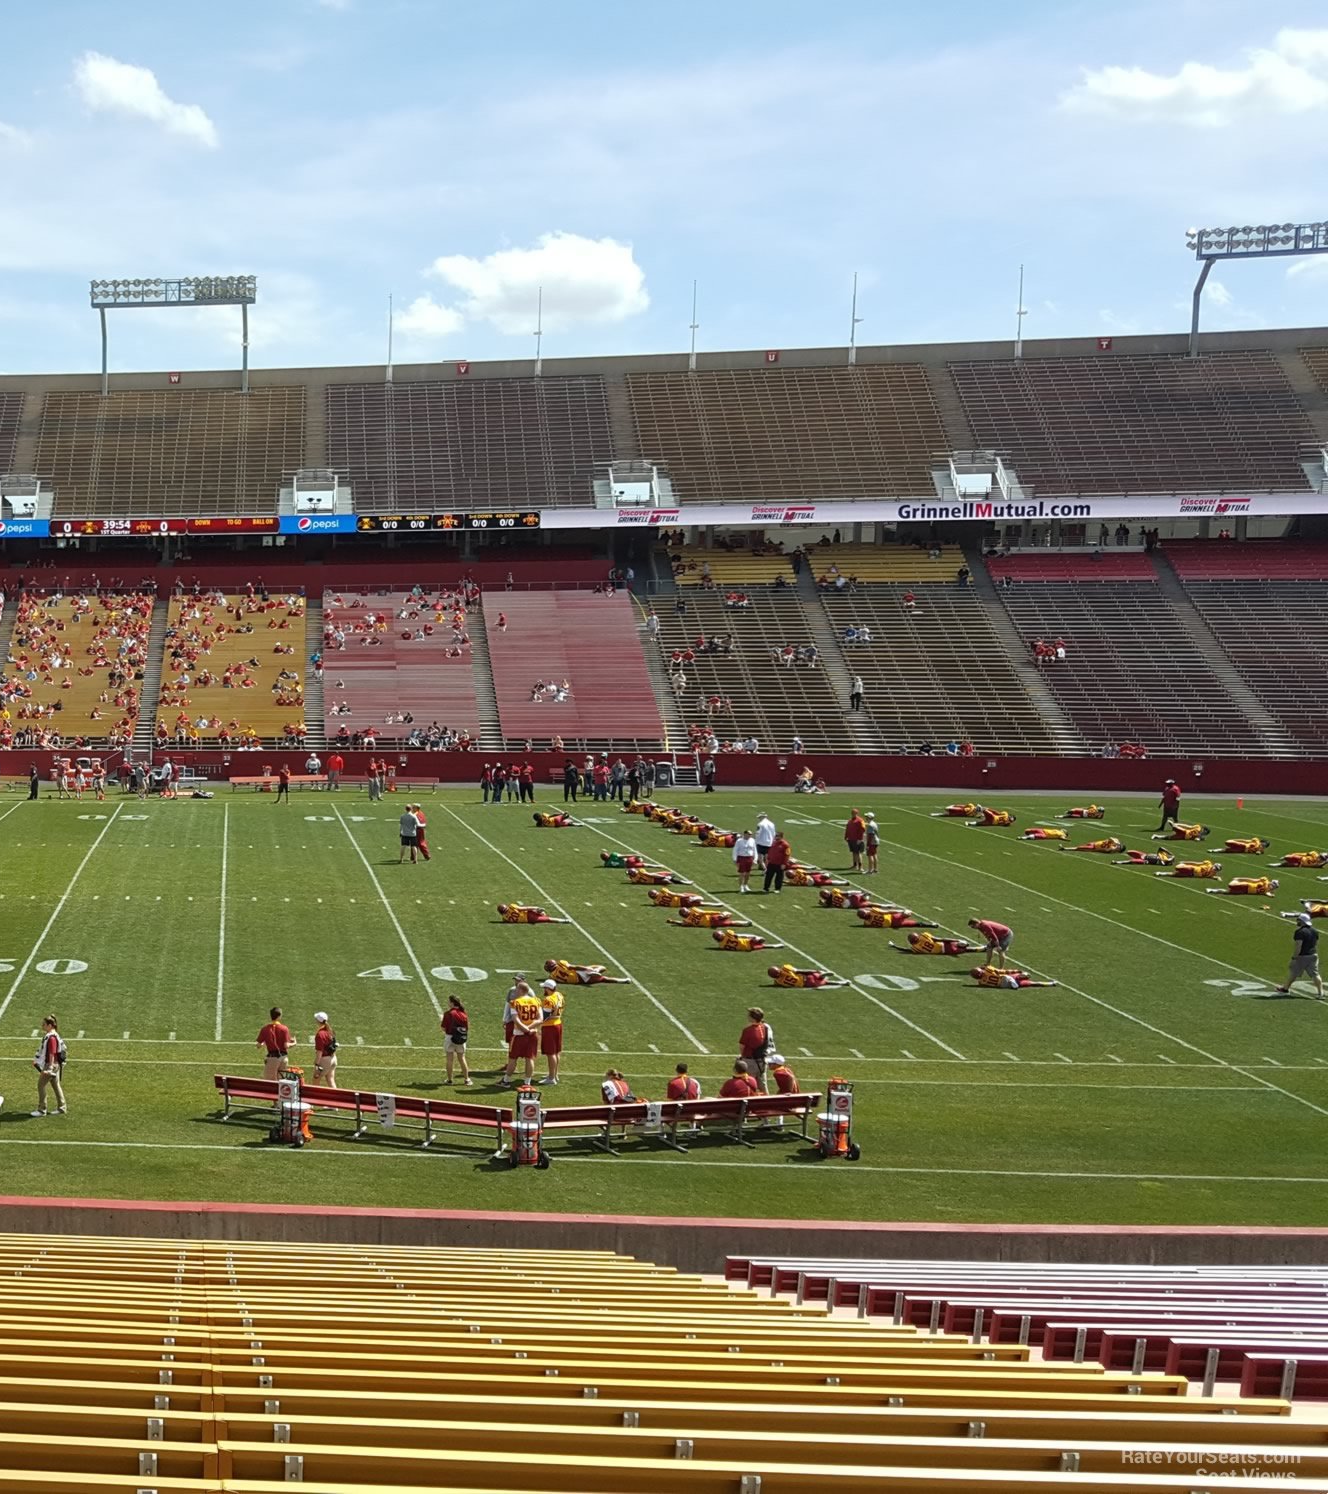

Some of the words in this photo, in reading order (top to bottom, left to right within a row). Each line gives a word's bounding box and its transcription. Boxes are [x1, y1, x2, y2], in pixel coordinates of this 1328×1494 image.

[1180, 497, 1217, 506] Discover
[898, 501, 1091, 519] GrinnellMutual.com
[7, 523, 32, 534] pepsi
[63, 522, 71, 533] 0
[103, 520, 131, 529] 39:54
[160, 521, 168, 532] 0
[313, 519, 339, 529] pepsi
[383, 521, 398, 529] 0/0
[410, 521, 425, 529] 0/0
[472, 519, 487, 527] 0/0
[499, 519, 514, 527] 0/0
[357, 965, 489, 983] 40
[521, 1004, 538, 1021] 58
